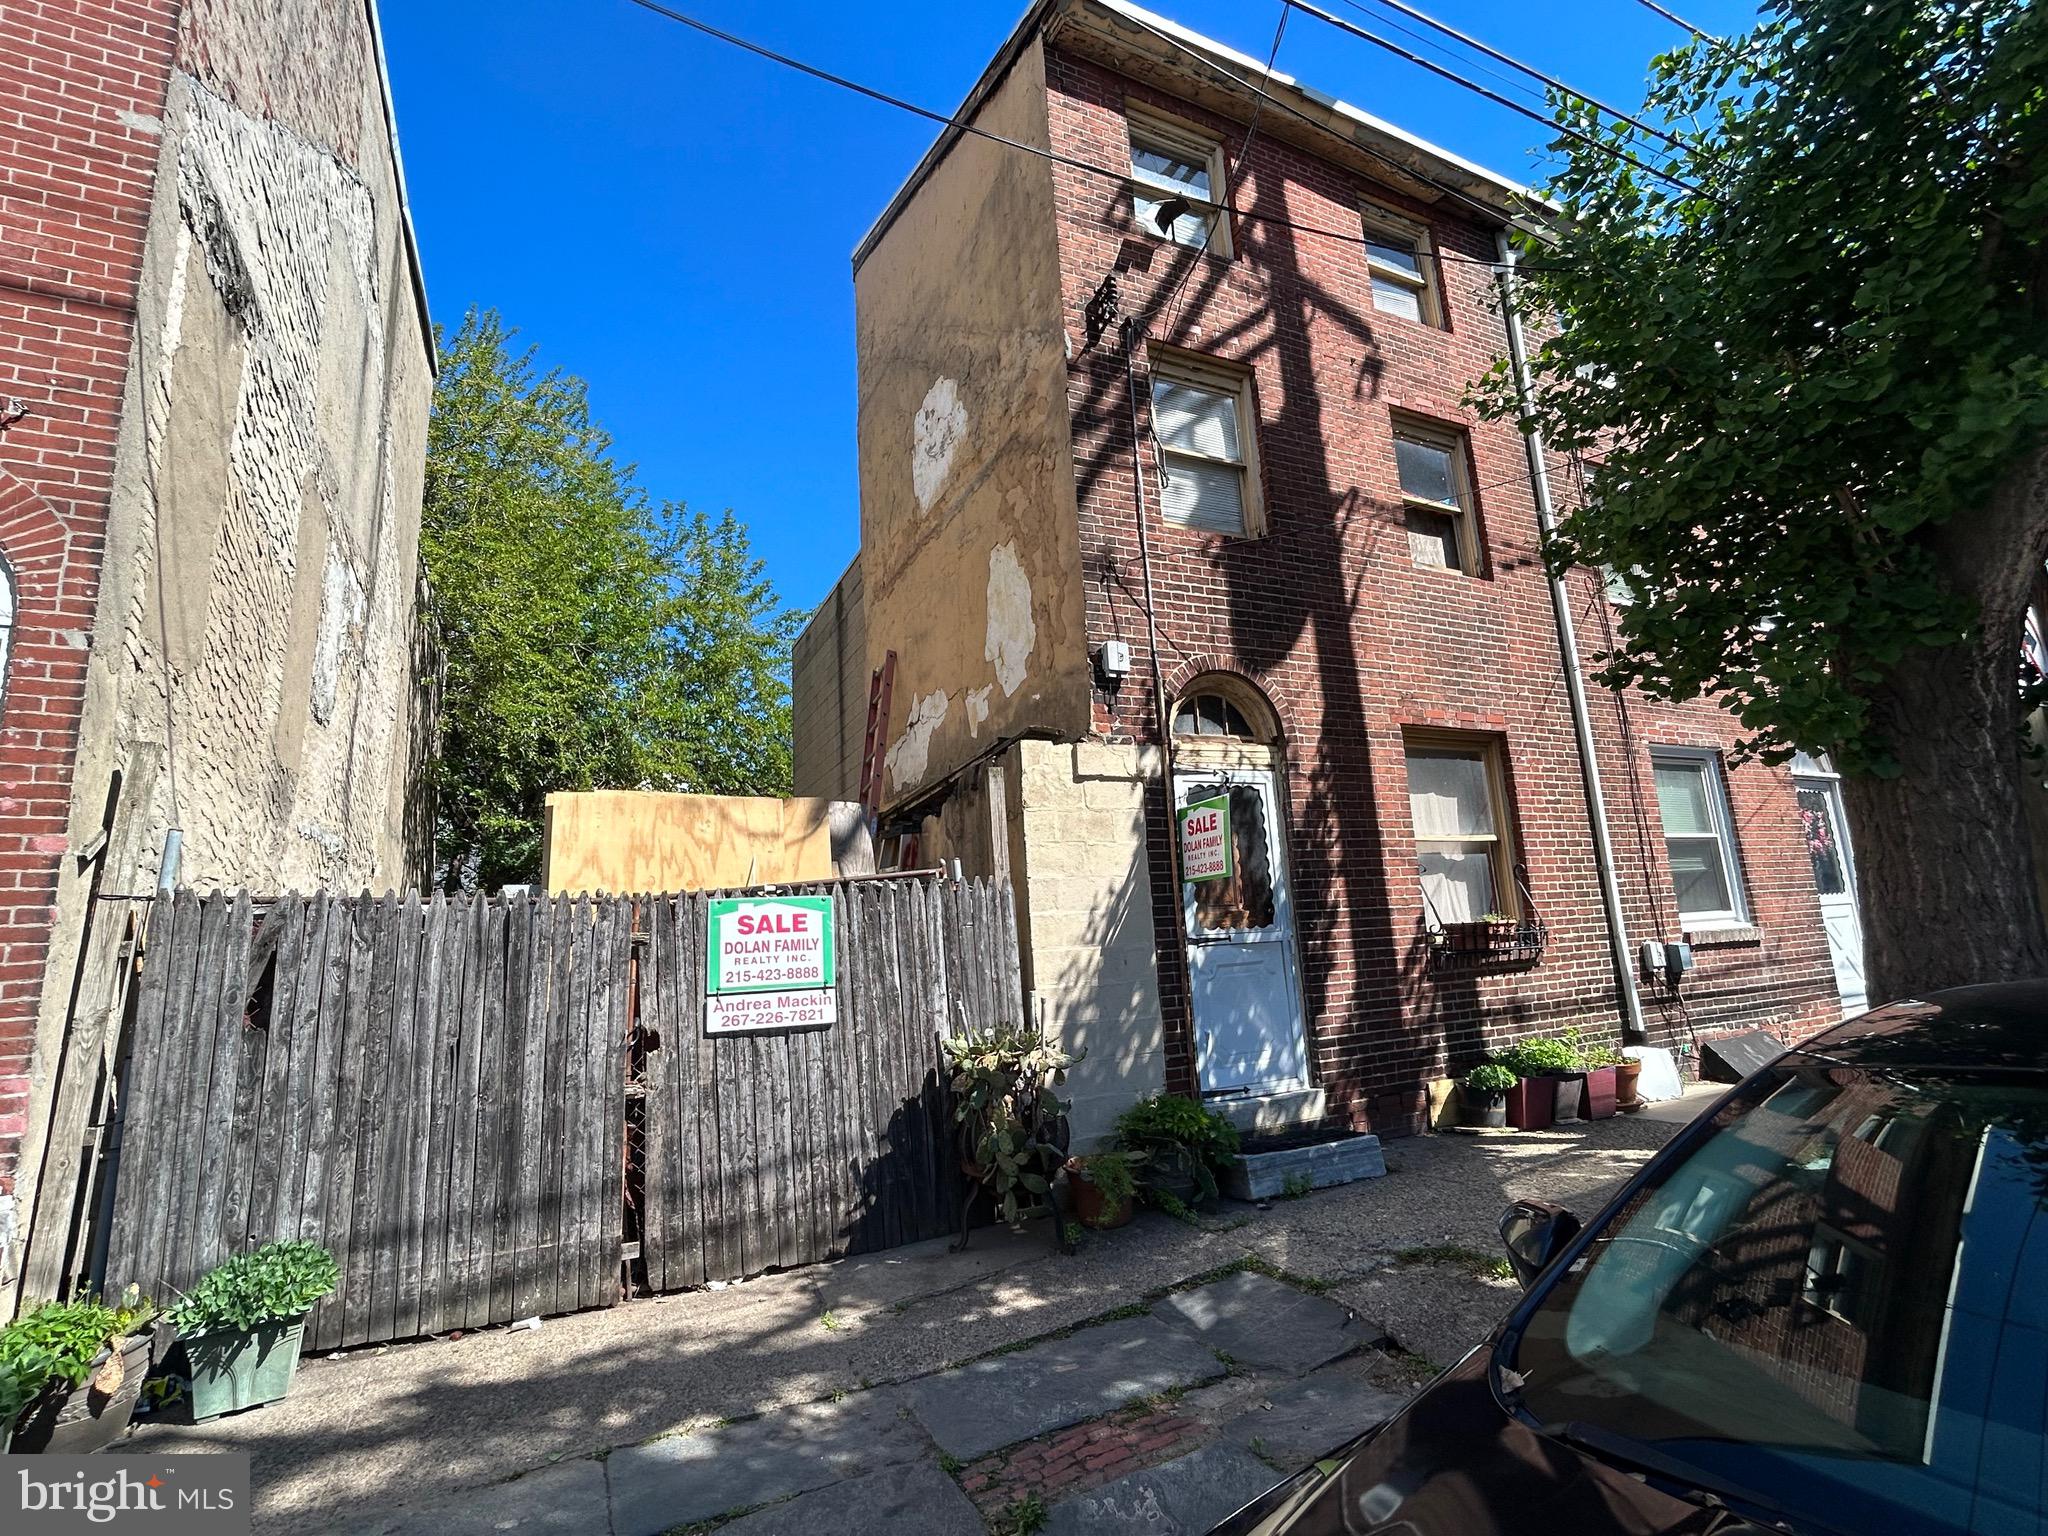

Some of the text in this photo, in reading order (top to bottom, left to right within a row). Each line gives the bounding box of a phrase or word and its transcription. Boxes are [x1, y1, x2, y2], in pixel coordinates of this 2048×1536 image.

[1187, 813, 1217, 836] SALE
[1184, 835, 1222, 853] DOLAN FAMILY
[1188, 850, 1219, 861] REALTY INC.
[1185, 860, 1224, 876] 215-423-8888
[737, 913, 808, 935] SALE
[724, 938, 819, 954] DOLAN FAMILY
[734, 954, 812, 965] REALTY INC.
[725, 966, 819, 983] 215-423-8888
[713, 994, 832, 1013] Andrea Mackin
[721, 1009, 824, 1027] 267-226-7821
